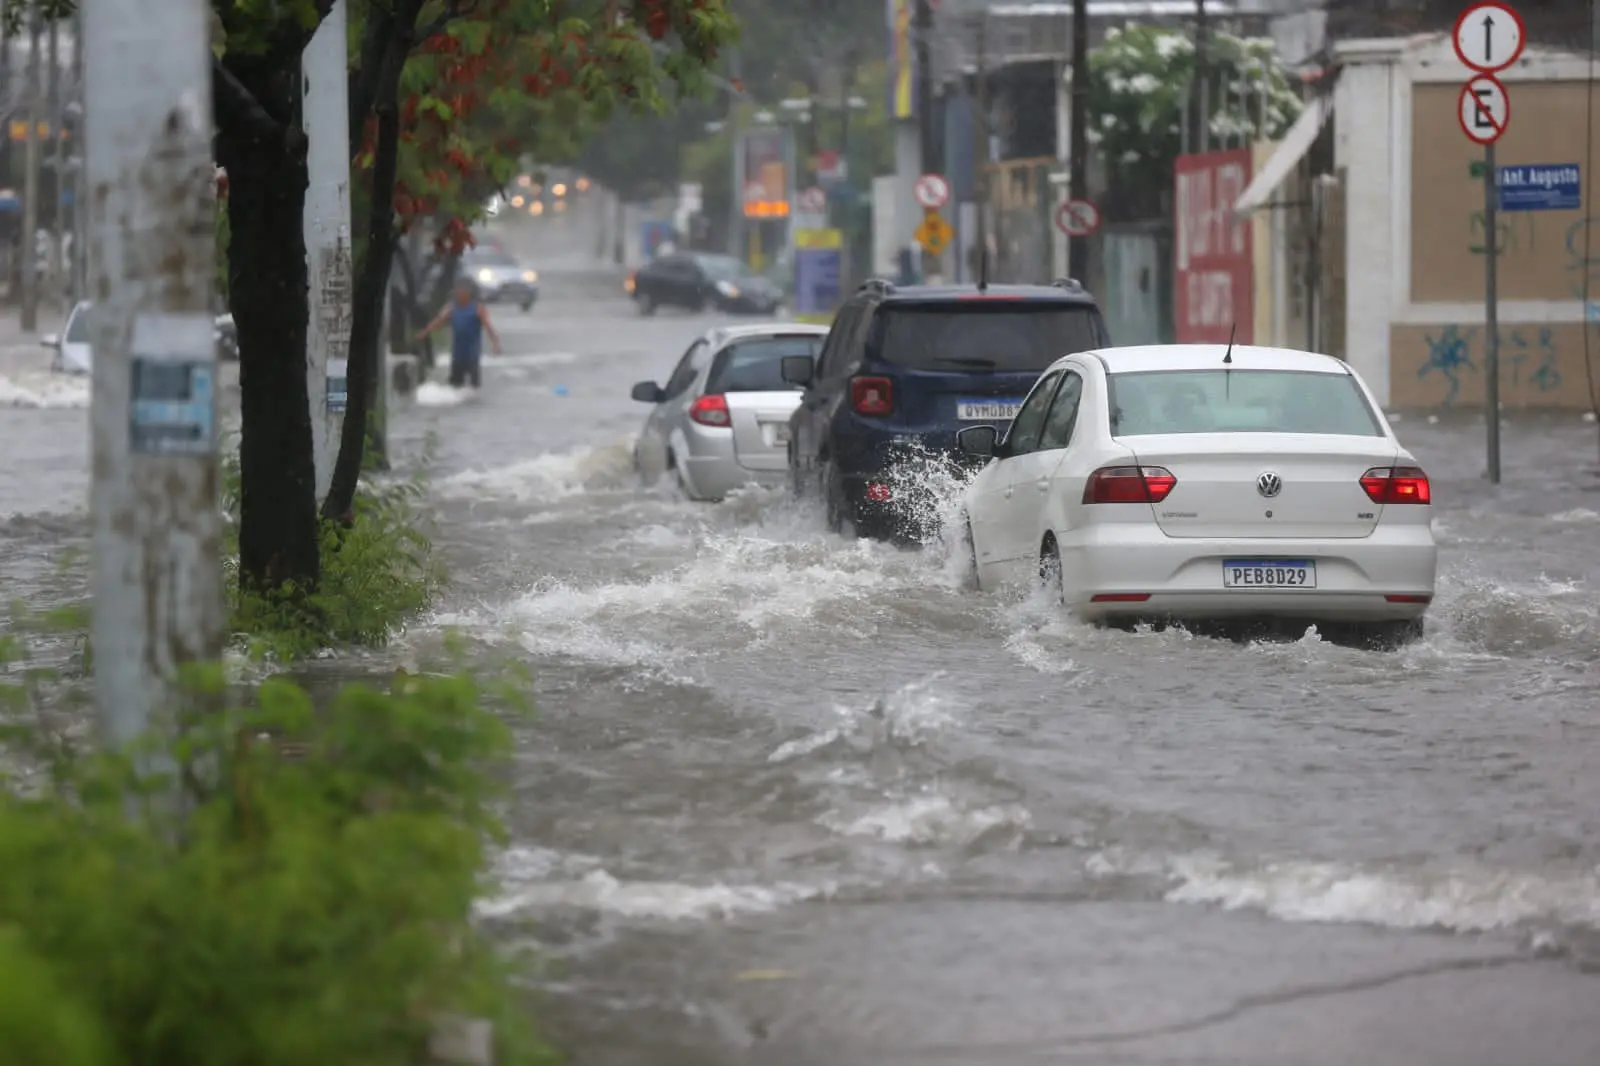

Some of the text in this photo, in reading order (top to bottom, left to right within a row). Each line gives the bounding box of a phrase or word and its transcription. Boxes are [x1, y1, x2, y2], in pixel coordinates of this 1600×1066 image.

[1475, 89, 1493, 128] E
[1503, 167, 1577, 189] Ant. Augusto
[1232, 568, 1307, 585] PEB8D29
